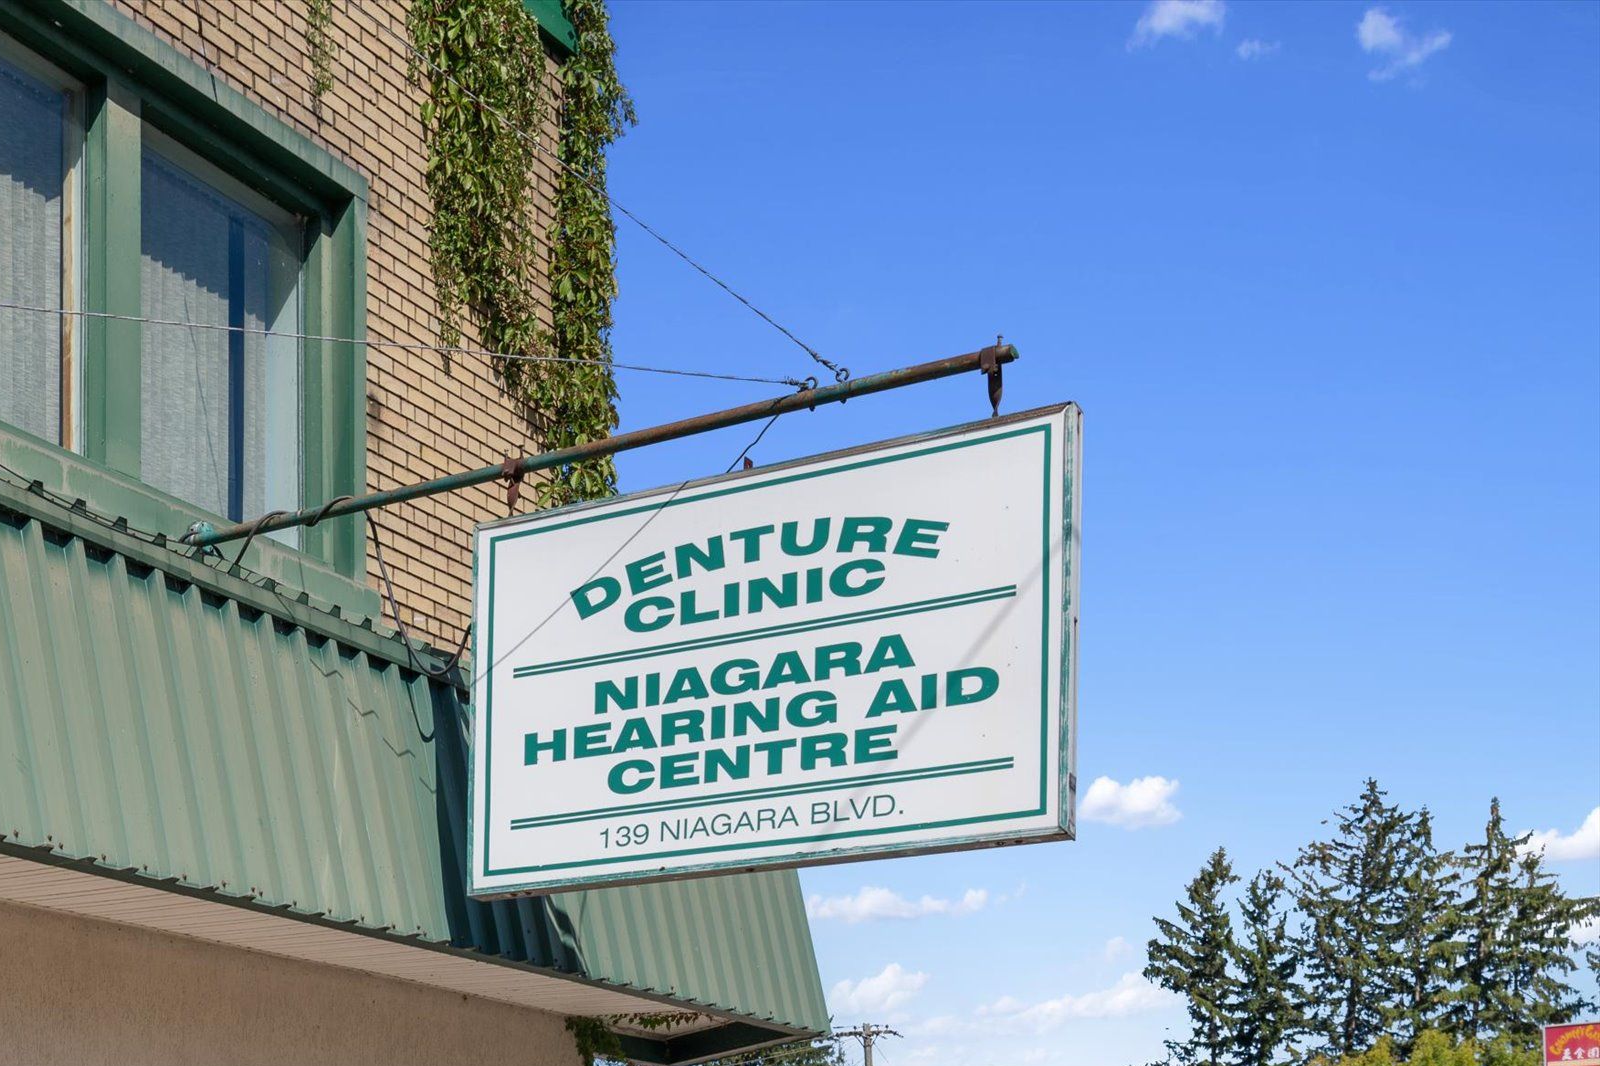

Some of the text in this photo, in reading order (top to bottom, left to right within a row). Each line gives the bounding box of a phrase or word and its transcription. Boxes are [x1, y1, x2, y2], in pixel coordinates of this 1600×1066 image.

[570, 516, 950, 621] DENTURE
[624, 558, 886, 633] CLINIC
[594, 633, 916, 715] NIAGARA
[524, 666, 1000, 766] HEARING AID
[607, 724, 899, 795] CENTRE
[599, 793, 905, 850] 139 NIAGARA BLVD.
